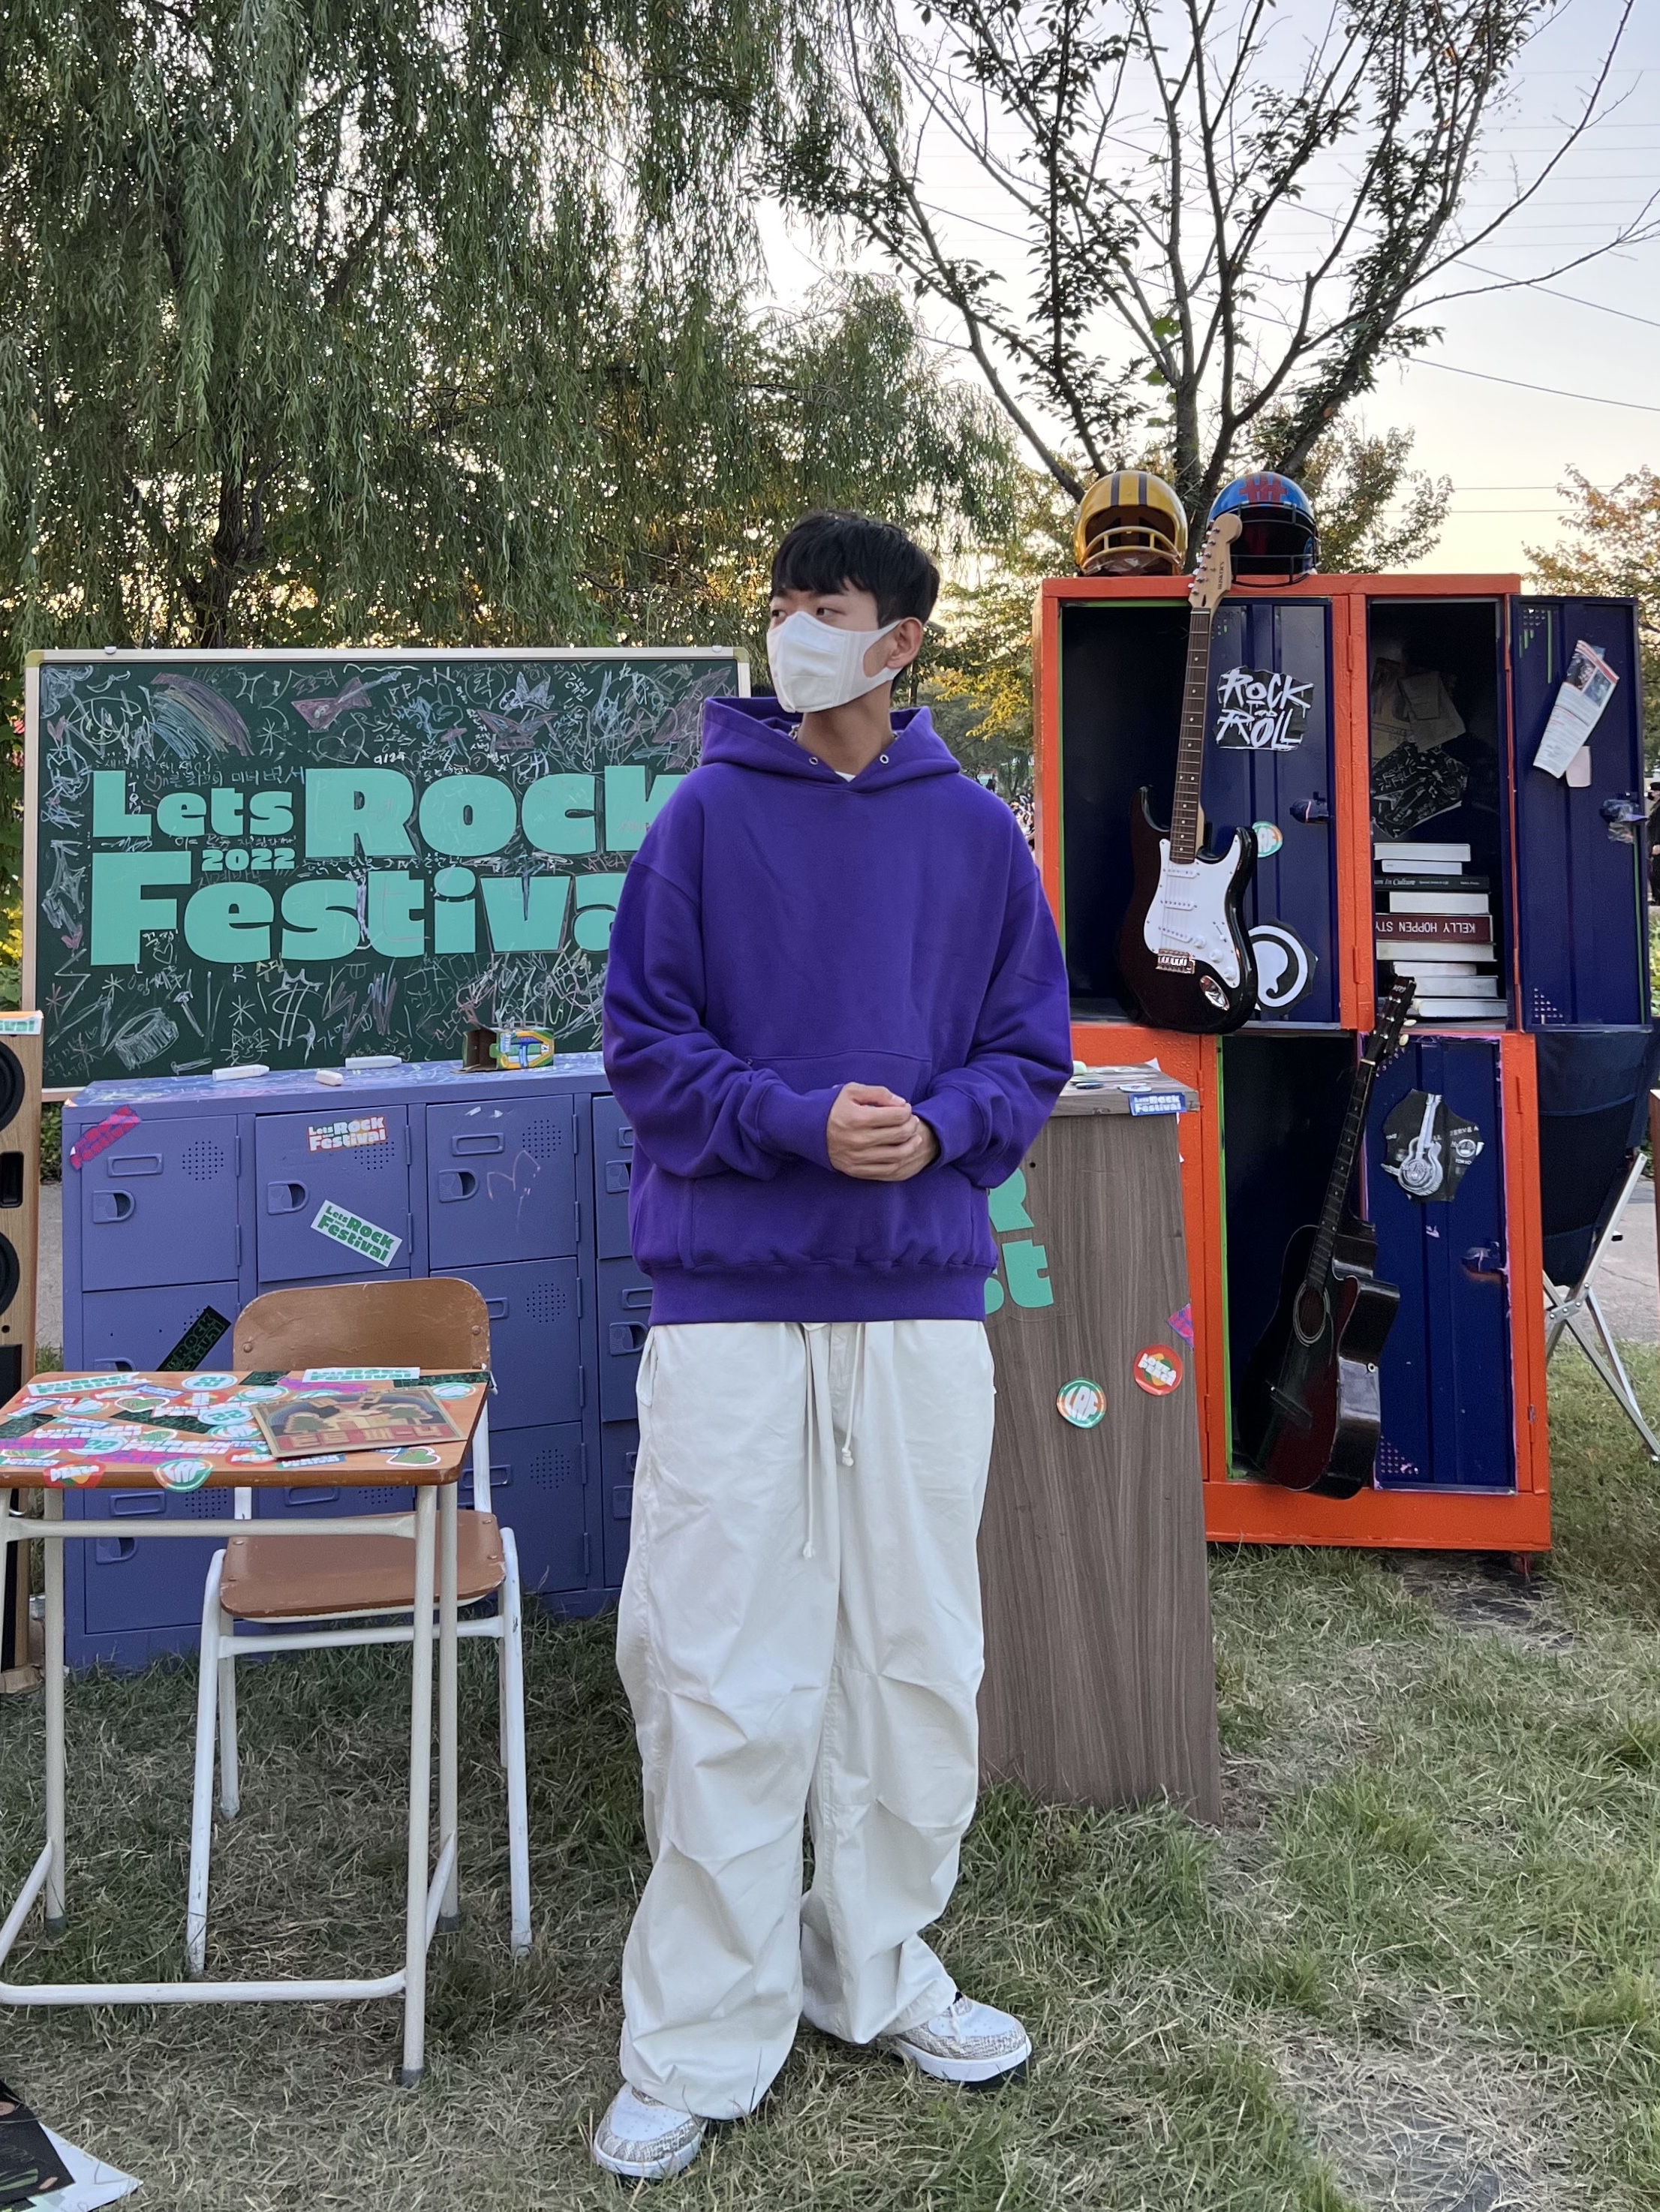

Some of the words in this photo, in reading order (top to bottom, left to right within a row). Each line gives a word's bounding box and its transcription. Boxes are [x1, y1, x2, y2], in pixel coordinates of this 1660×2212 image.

[1217, 669, 1315, 708] ROCK
[1216, 708, 1303, 751] ROLL
[92, 770, 294, 837] Lets
[305, 765, 688, 858] Rock
[201, 848, 296, 871] 2022
[1399, 921, 1438, 933] HOPPEN
[1443, 922, 1476, 933] KELLY
[1135, 1102, 1182, 1114] Festival
[1149, 1095, 1180, 1104] Rock
[308, 1126, 334, 1136] Lets
[333, 1117, 385, 1135] Rock
[309, 1129, 386, 1151] Festival
[317, 1214, 389, 1261] Festival
[325, 1205, 349, 1223] Lets
[346, 1216, 395, 1250] Rock
